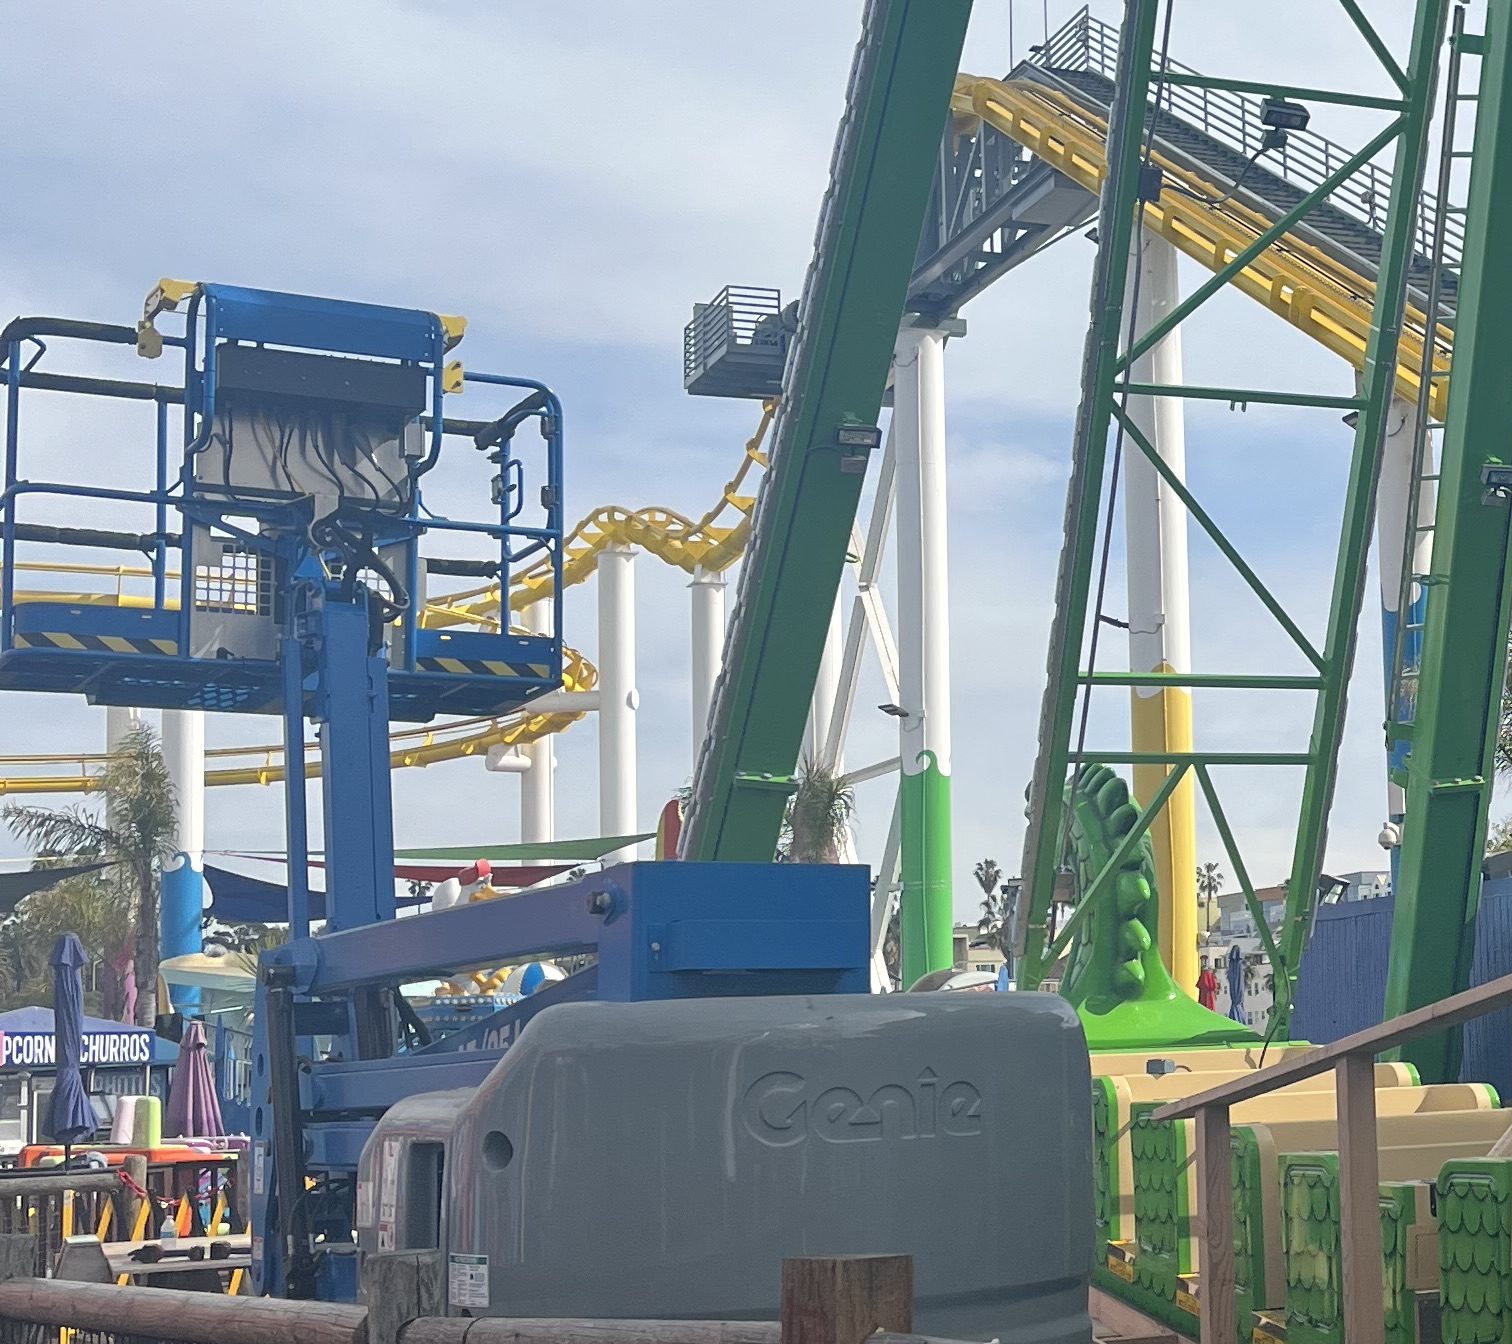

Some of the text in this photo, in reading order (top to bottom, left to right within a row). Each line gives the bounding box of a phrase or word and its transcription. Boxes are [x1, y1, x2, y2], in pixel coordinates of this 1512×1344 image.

[3, 1033, 151, 1065] PCORN CHURROS
[743, 1066, 983, 1148] Genie
